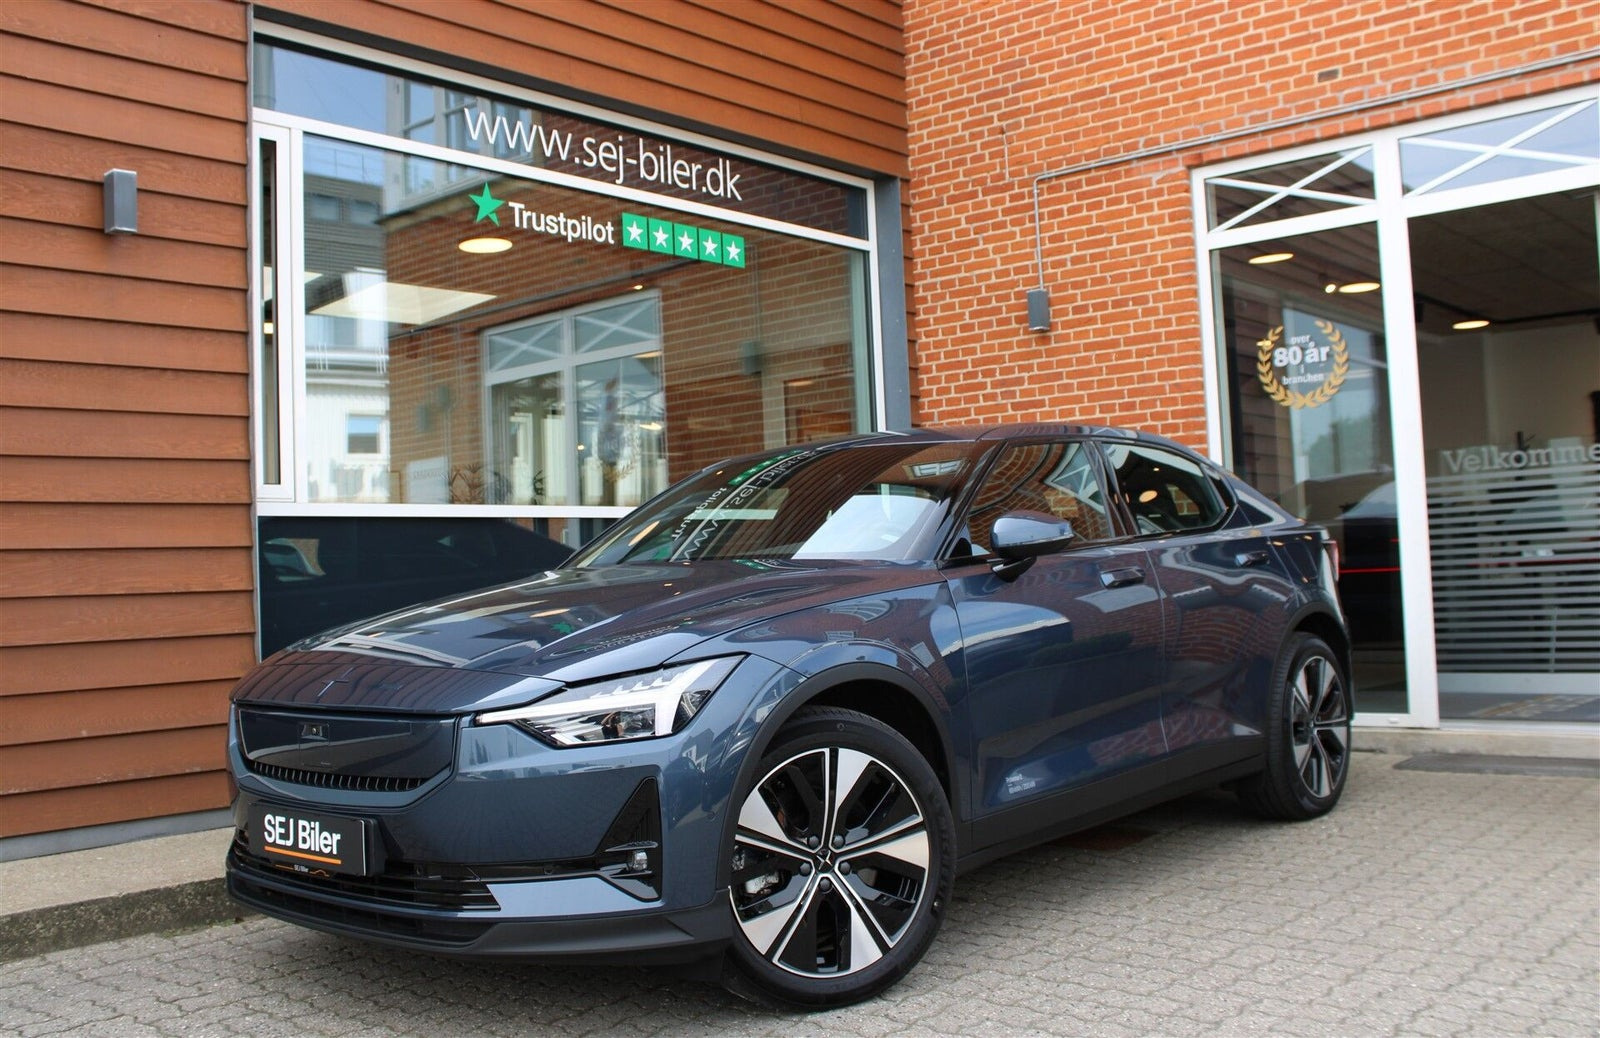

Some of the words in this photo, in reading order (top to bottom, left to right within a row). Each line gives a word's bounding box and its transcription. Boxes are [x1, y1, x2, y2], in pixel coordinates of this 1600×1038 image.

[464, 108, 742, 200] www.sej-biler.dk
[508, 201, 614, 244] Trustpilot
[1273, 346, 1302, 367] 80
[1306, 341, 1330, 363] år
[1282, 374, 1324, 385] branchen
[264, 813, 294, 847] SEJ
[298, 819, 341, 855] Biler
